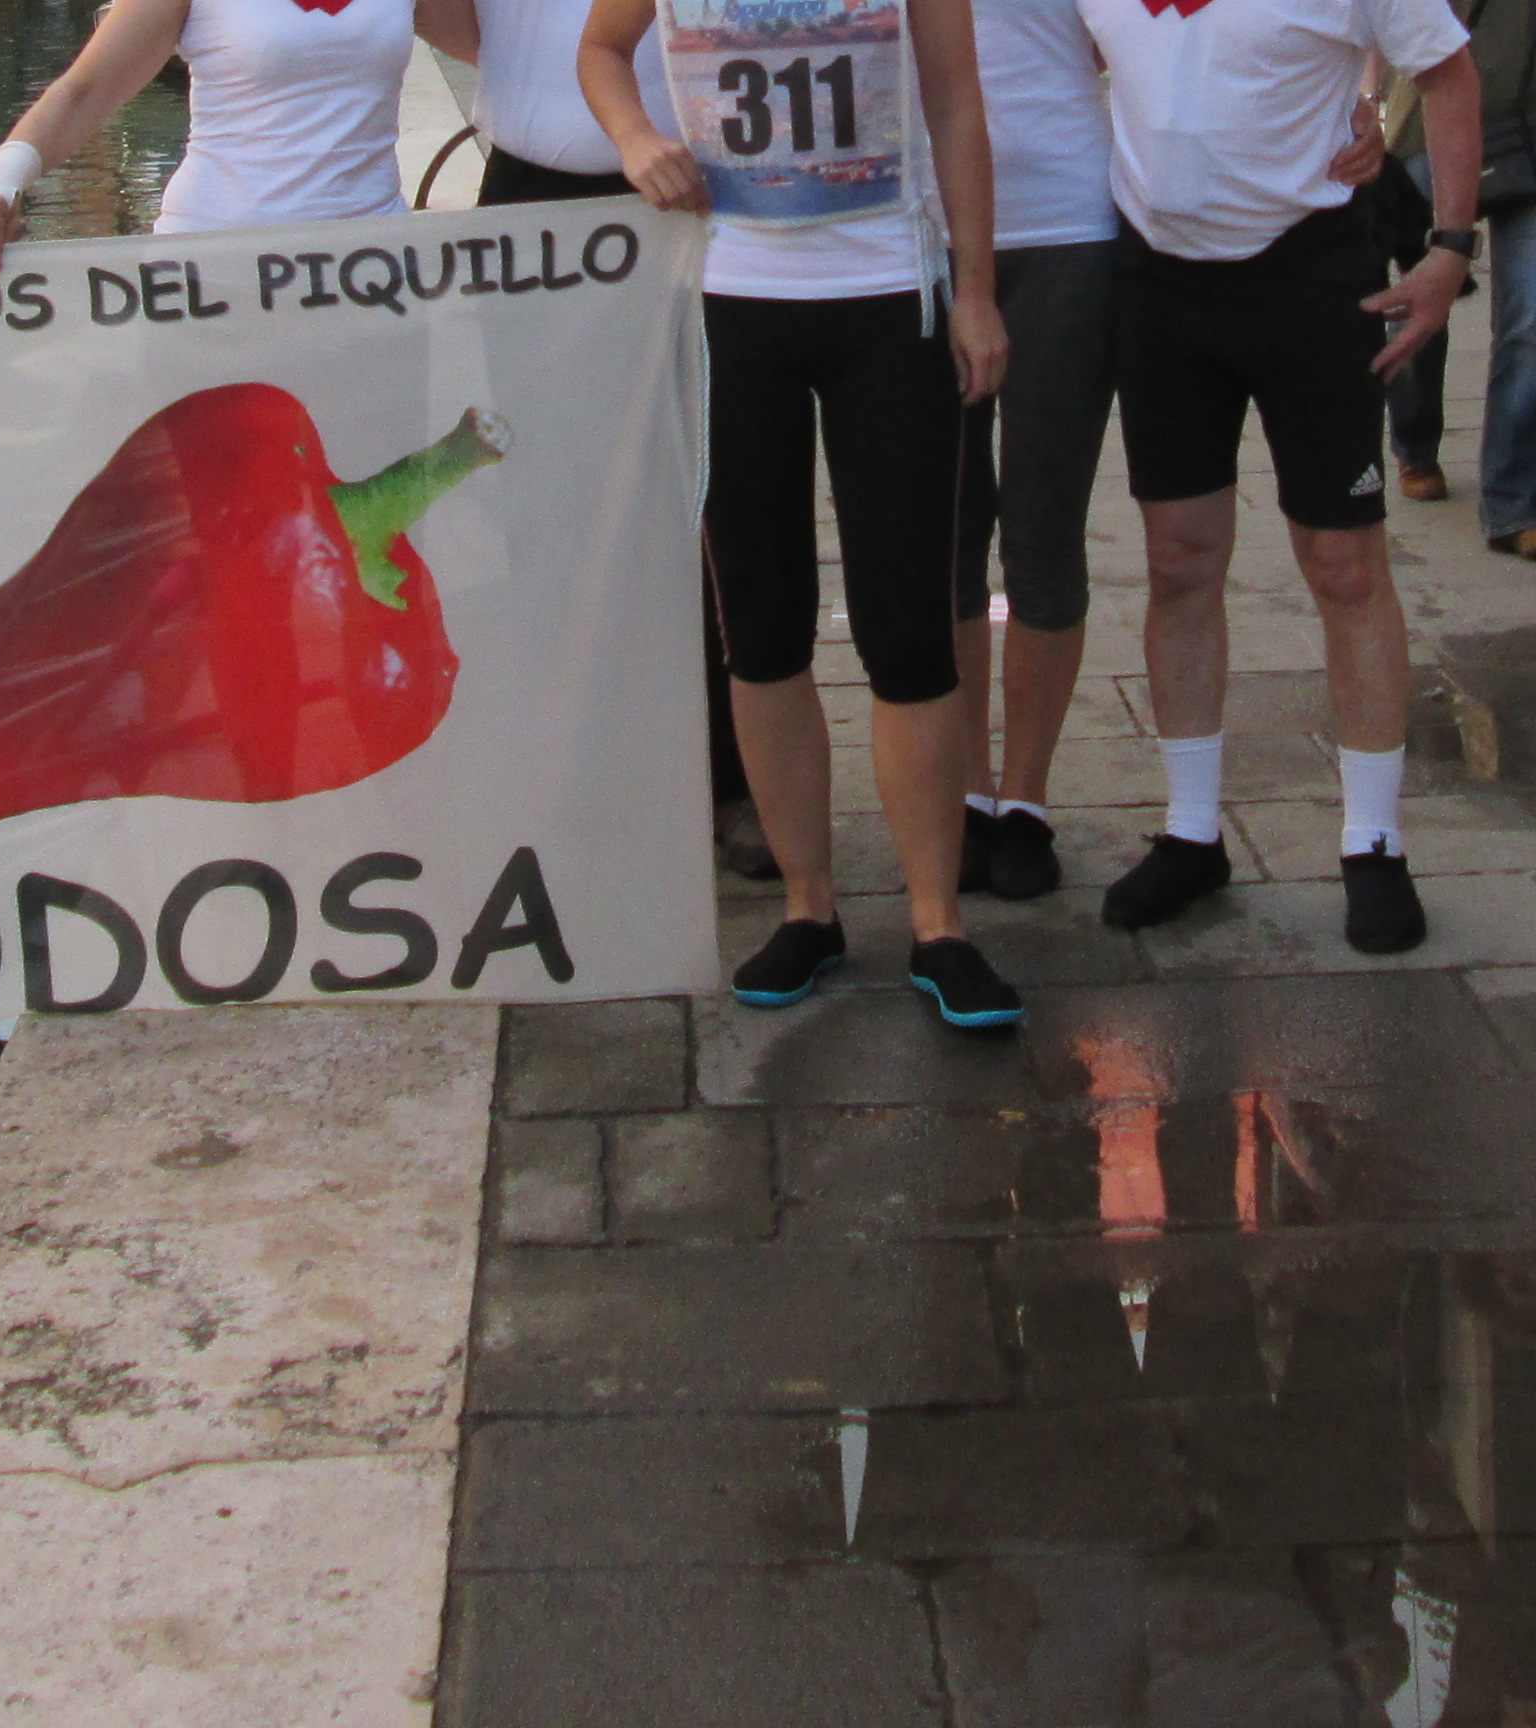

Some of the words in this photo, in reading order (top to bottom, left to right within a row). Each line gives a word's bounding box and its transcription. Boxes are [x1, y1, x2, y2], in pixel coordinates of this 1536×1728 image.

[718, 54, 857, 156] 311
[87, 259, 230, 326] DEL
[257, 222, 639, 316] PIQUILLO
